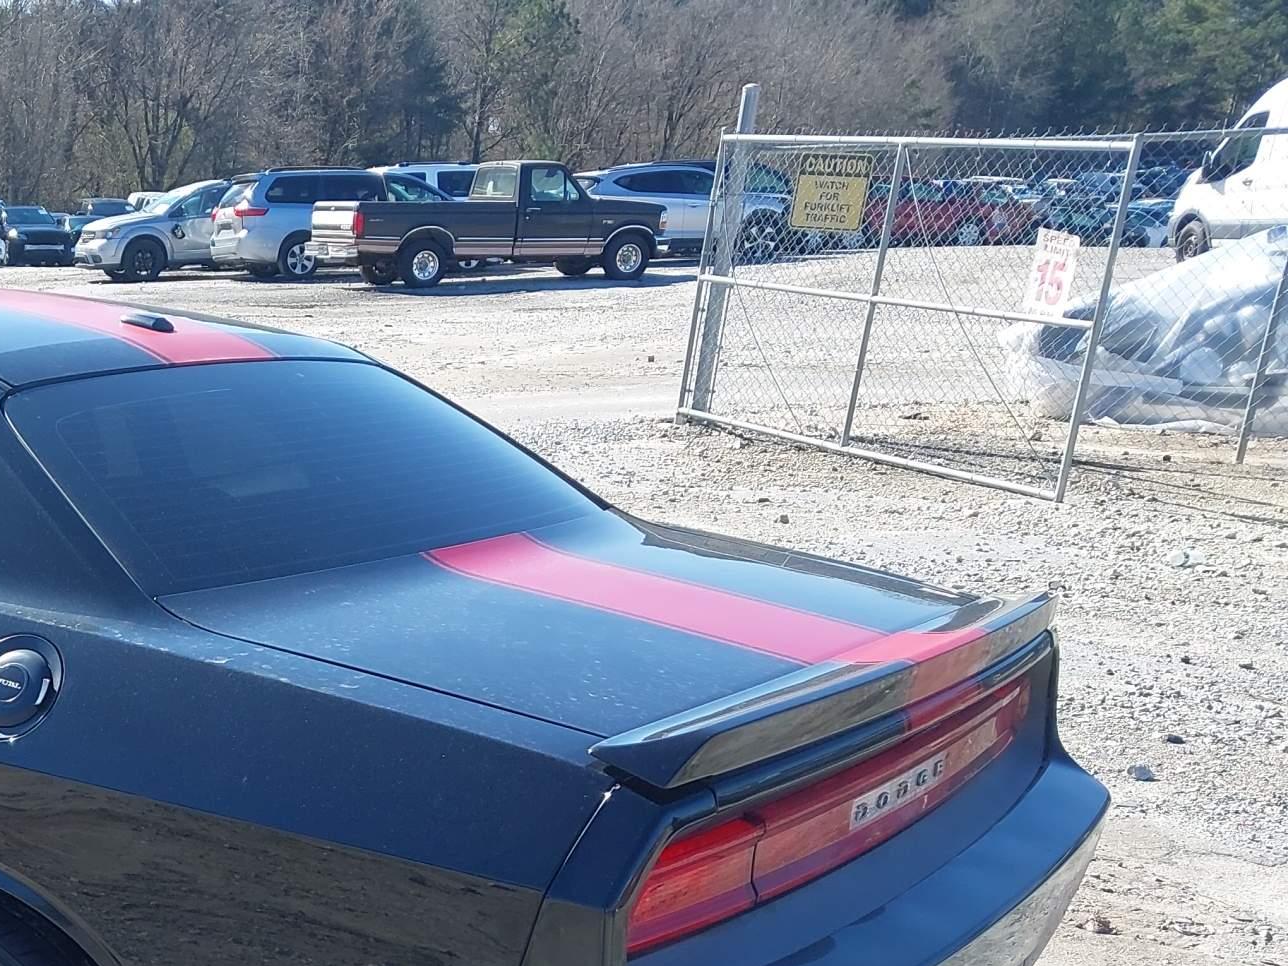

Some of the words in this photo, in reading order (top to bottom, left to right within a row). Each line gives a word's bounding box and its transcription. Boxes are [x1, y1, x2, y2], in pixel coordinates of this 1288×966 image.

[805, 158, 868, 174] CAUTION
[815, 181, 849, 190] WATCH
[819, 192, 840, 201] FOR
[803, 202, 852, 213] FORKLIFT
[805, 213, 847, 223] TRAFFIC
[1037, 259, 1066, 305] 15
[854, 759, 944, 821] DODGE
